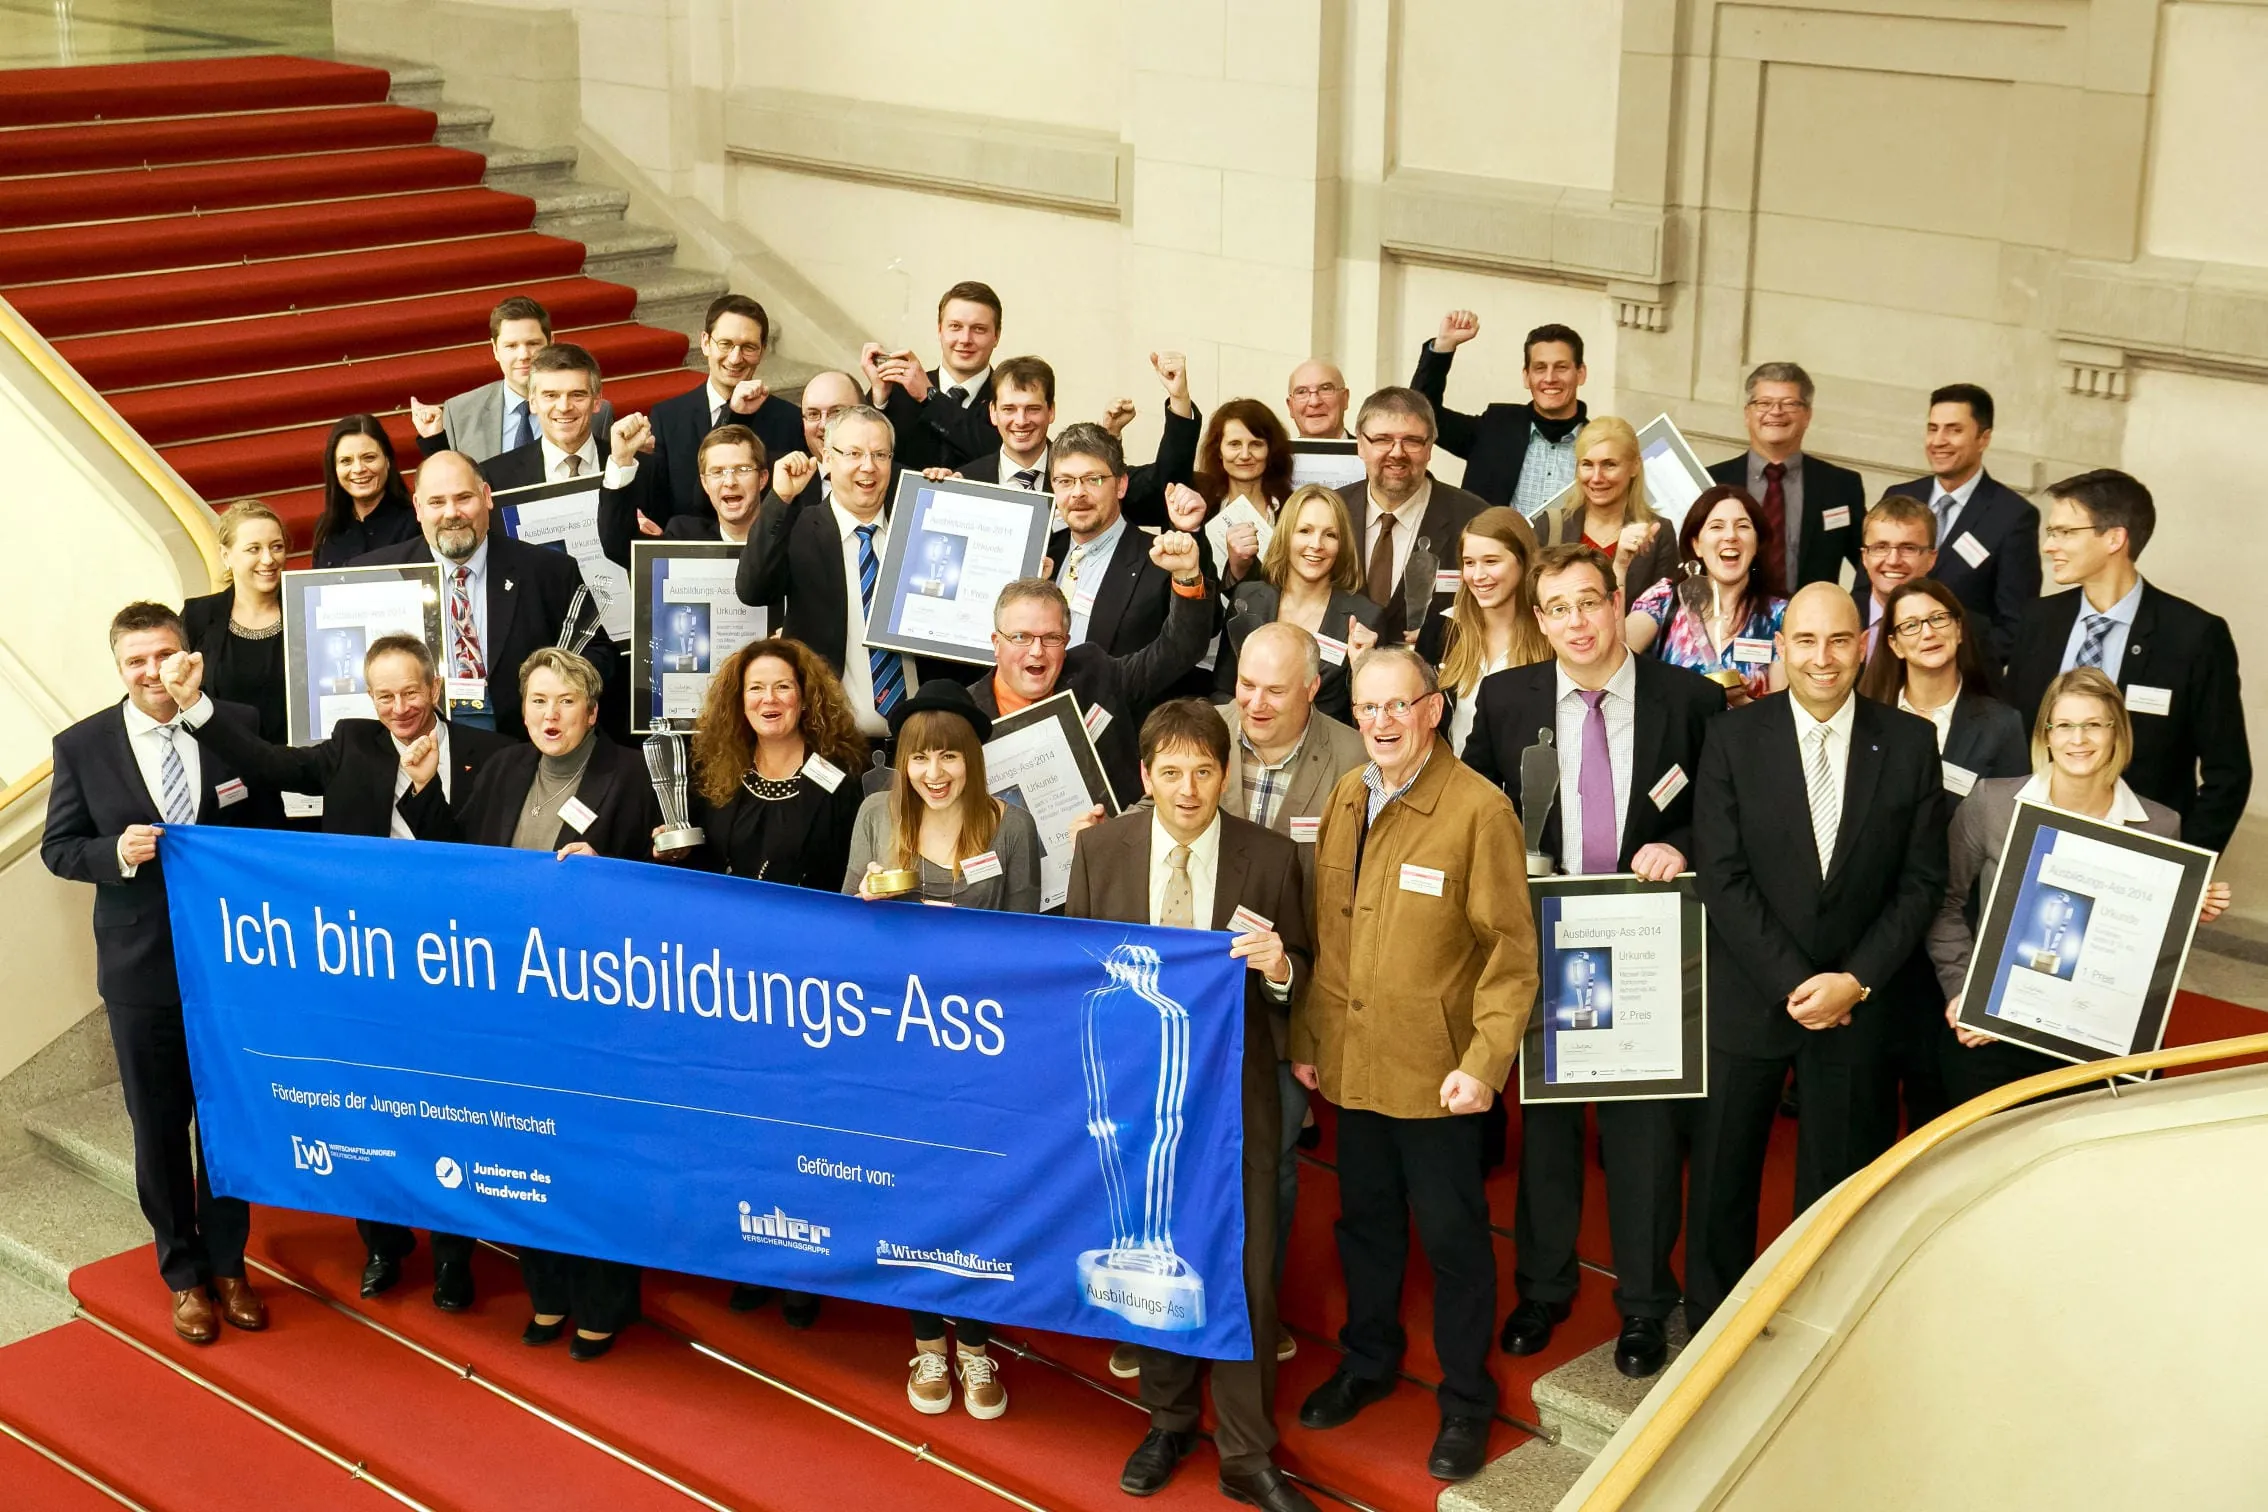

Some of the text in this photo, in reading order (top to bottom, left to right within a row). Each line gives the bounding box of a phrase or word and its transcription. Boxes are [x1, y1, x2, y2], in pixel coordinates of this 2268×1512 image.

[669, 585, 731, 597] Ausbildungs-Ass
[716, 607, 747, 616] Urkunde
[1034, 751, 1055, 766] 2014
[1026, 775, 1058, 793] Urkunde
[1055, 830, 1070, 842] Pre
[2128, 883, 2153, 903] 2014
[1562, 926, 1662, 940] Ausbildungs-Ass 2014
[1619, 951, 1656, 961] Urkunde
[219, 897, 1006, 1056] Ich bin ein Ausbildungs-Ass
[1630, 1010, 1652, 1021] Preis
[271, 1082, 557, 1136] Förderpreis der Jungen Deutschen Wirtschaft
[329, 1143, 397, 1157] WIRTSCHAFTSJUNIOREN
[473, 1161, 552, 1184] Junioren des
[797, 1154, 896, 1188] Gefördert von:
[475, 1181, 547, 1203] Handwerks
[738, 1200, 831, 1244] inter
[741, 1234, 831, 1256] VERSICHERUNGSGRUPPE
[890, 1243, 1013, 1272] WirtschaftsKurier
[1086, 1282, 1185, 1319] Ausbildungs-Ass
